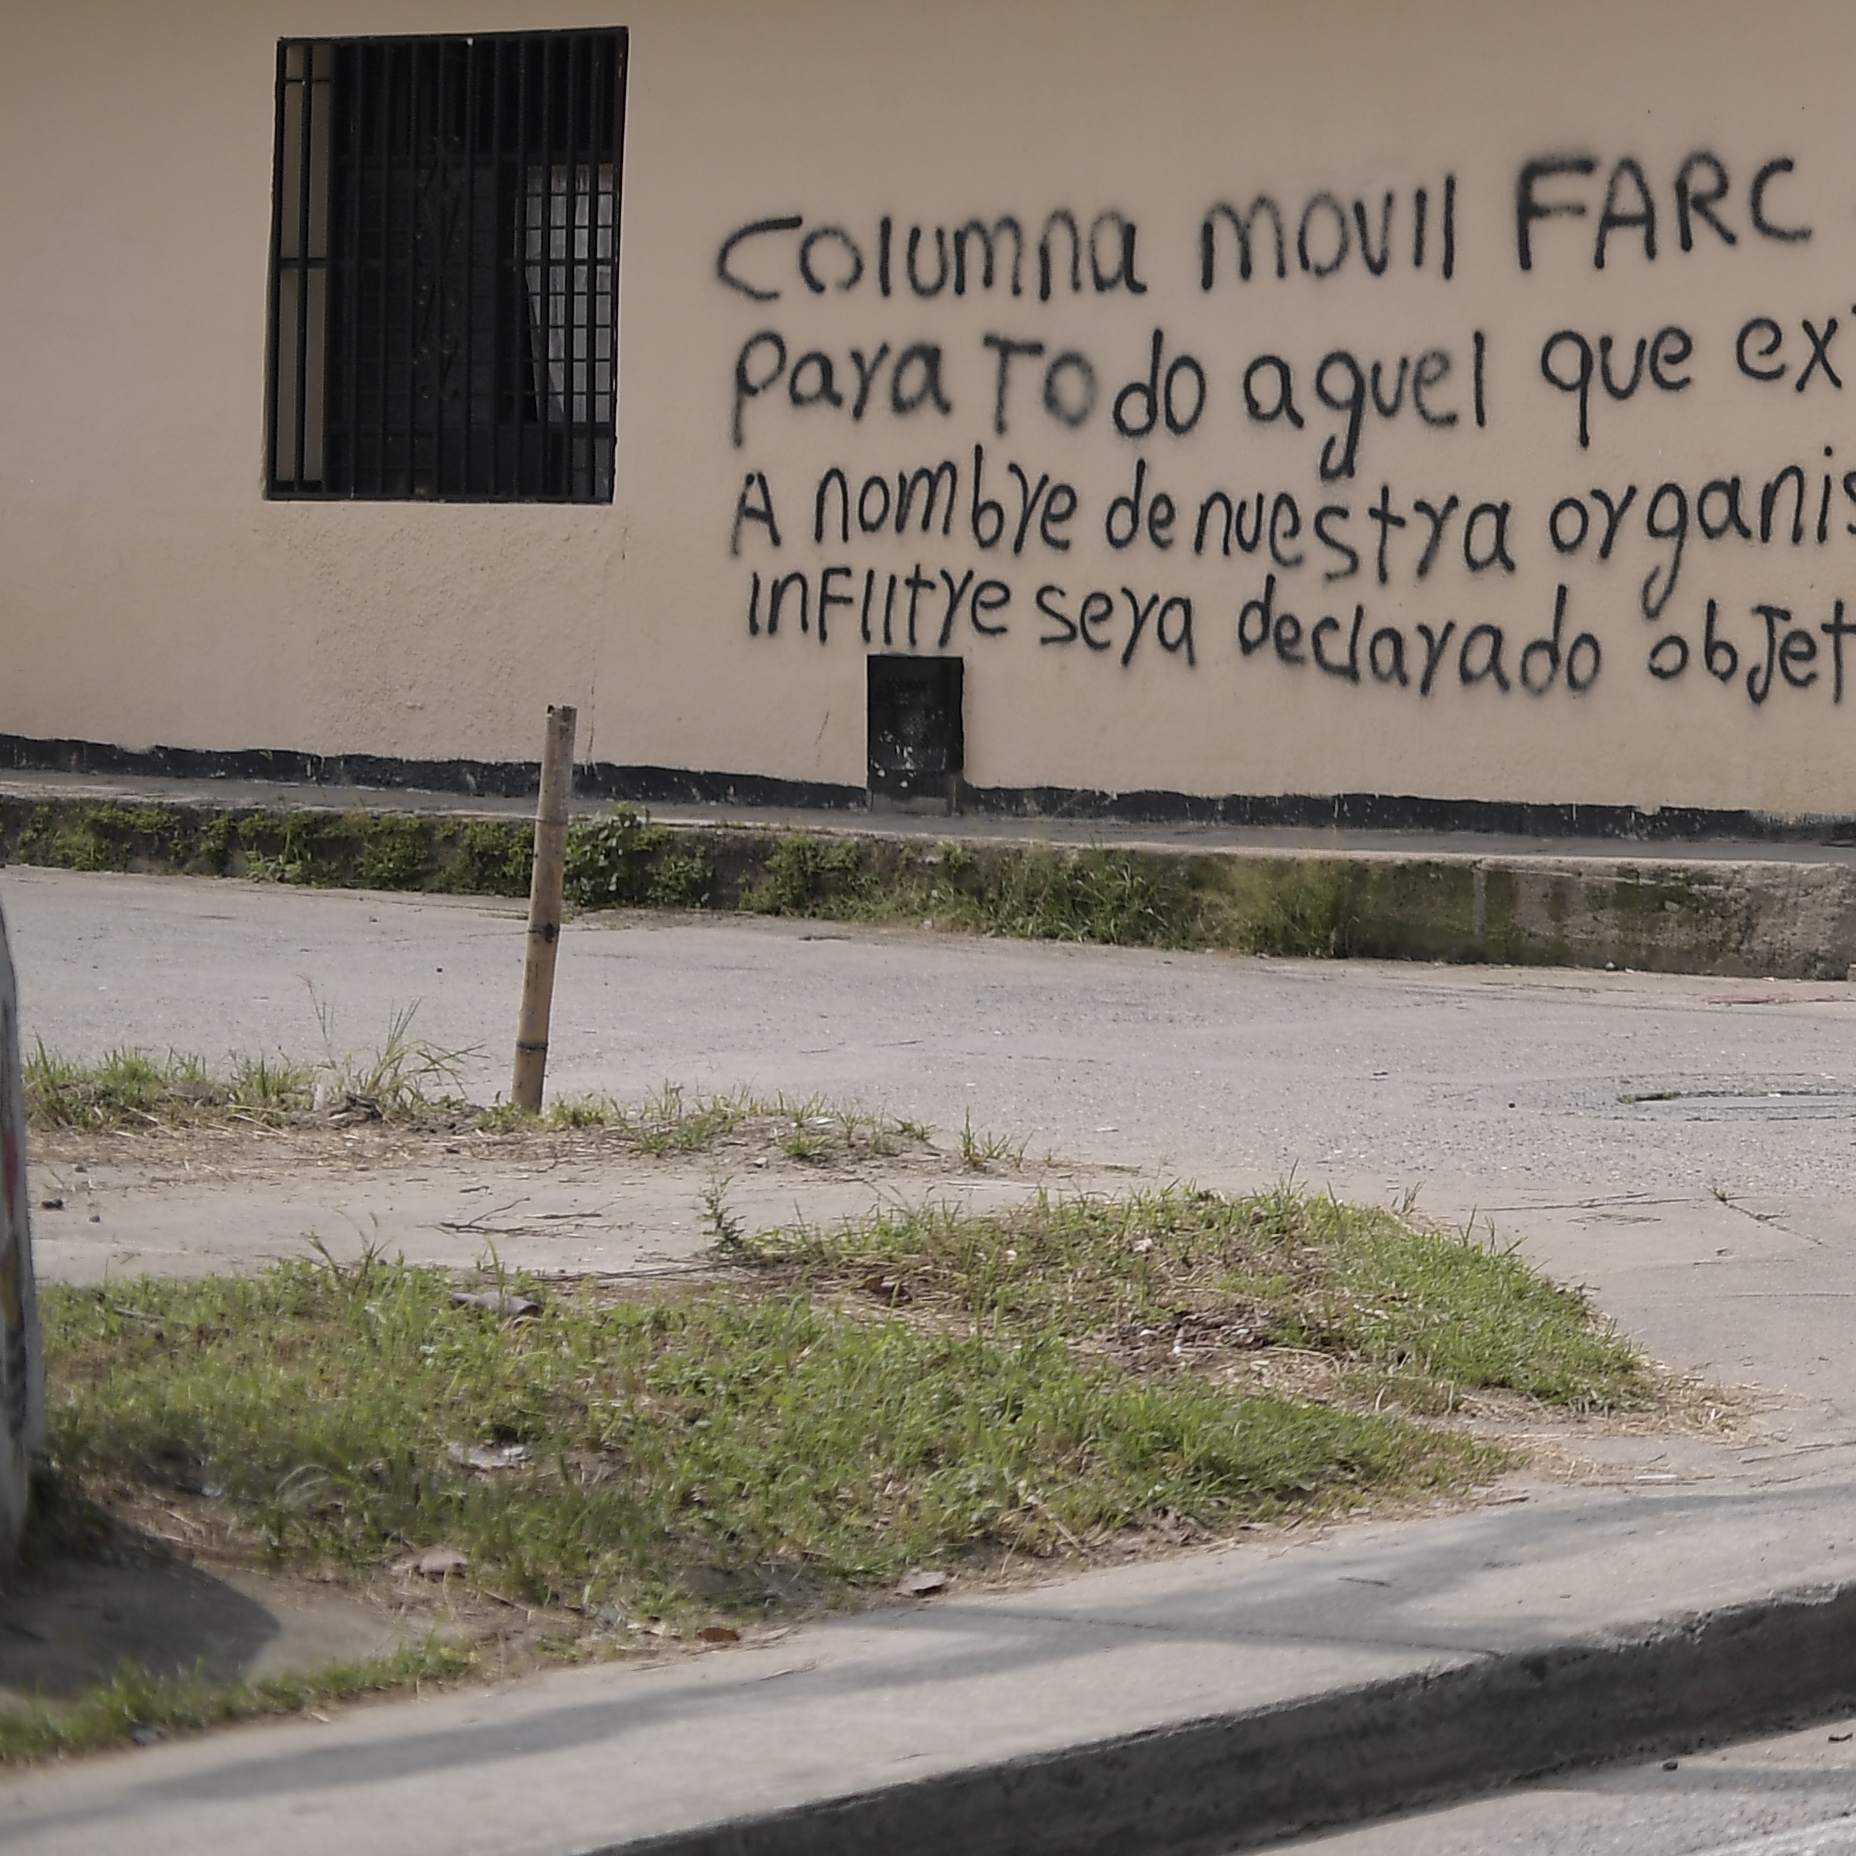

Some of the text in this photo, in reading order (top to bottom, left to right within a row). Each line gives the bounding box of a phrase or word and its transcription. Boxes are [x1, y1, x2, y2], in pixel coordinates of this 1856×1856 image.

[1514, 150, 1814, 273] FARC
[1538, 325, 1696, 452] que
[811, 442, 1080, 559] nombre
